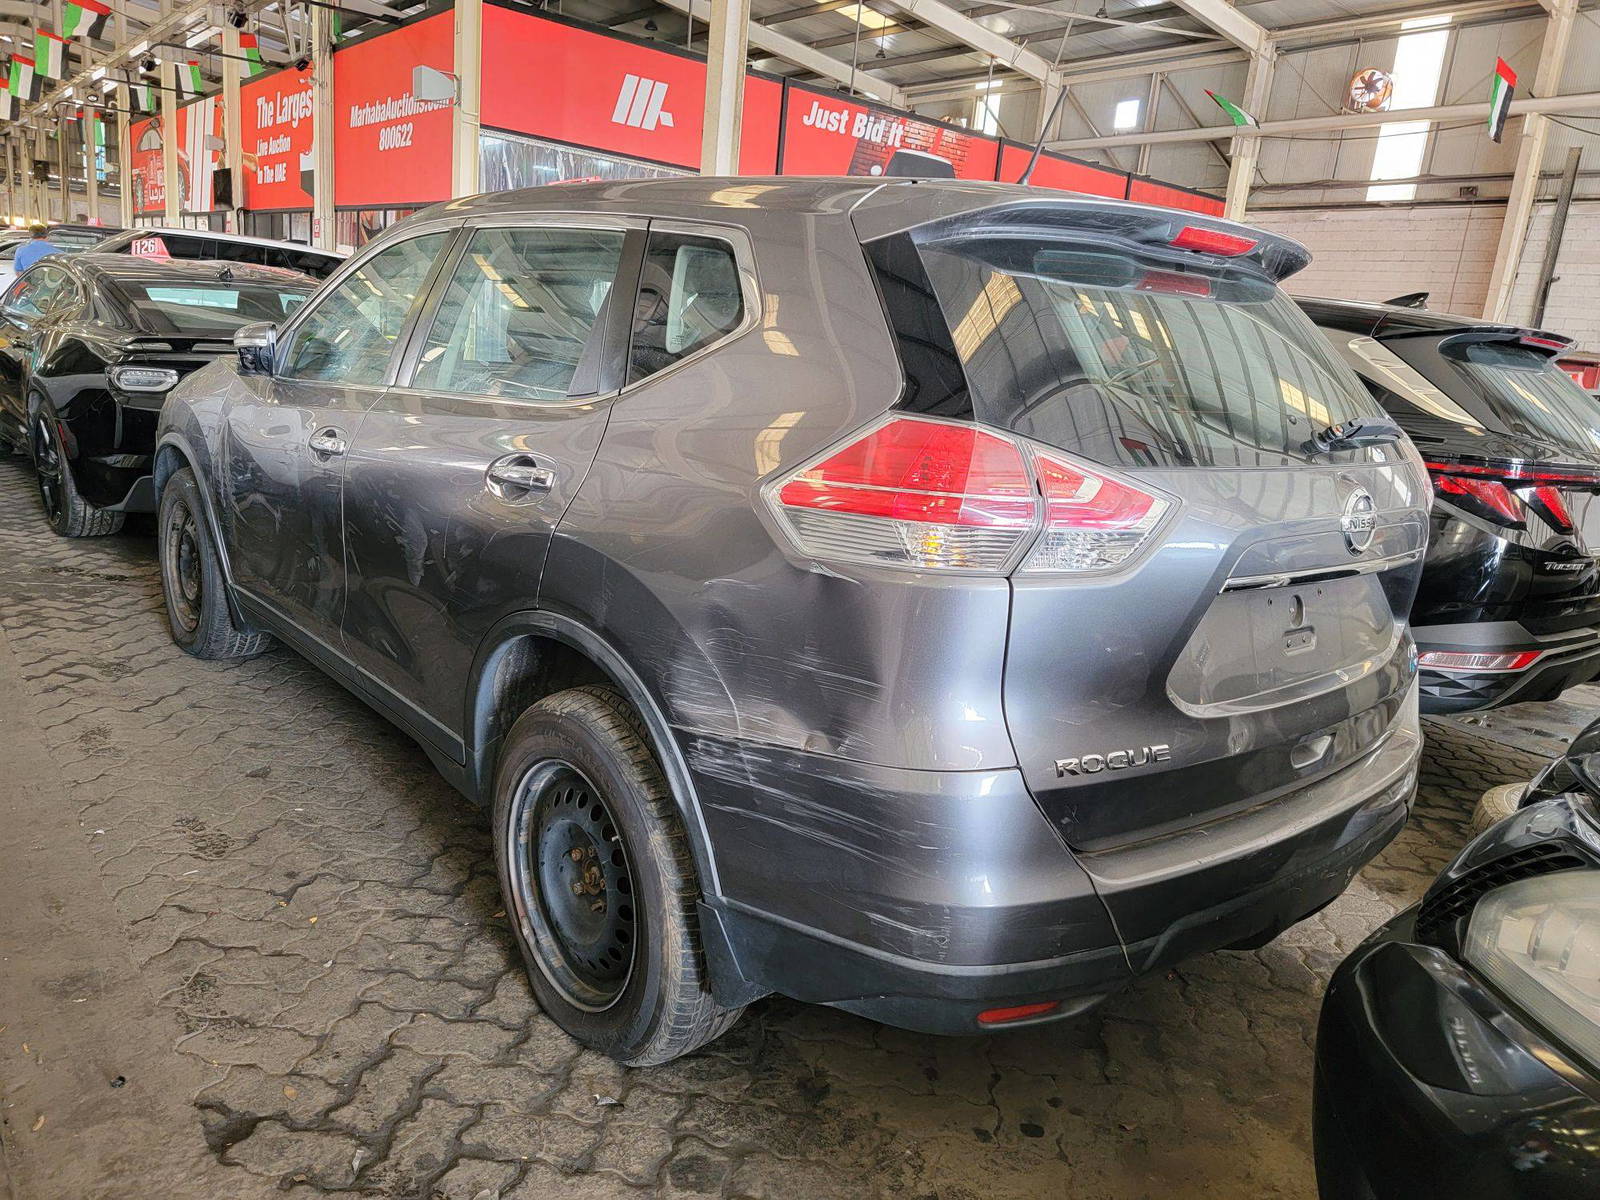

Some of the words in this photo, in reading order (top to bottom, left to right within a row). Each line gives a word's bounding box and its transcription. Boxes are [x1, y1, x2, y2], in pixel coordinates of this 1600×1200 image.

[256, 96, 274, 129] The
[275, 91, 312, 128] Larges
[379, 122, 413, 151] 800622
[803, 101, 849, 134] Just
[852, 112, 886, 143] Bid
[887, 122, 904, 148] It
[256, 139, 268, 157] Live
[269, 134, 290, 155] Auction
[264, 165, 274, 183] The
[275, 162, 287, 182] UAE
[135, 239, 155, 255] 126
[1544, 561, 1585, 571] Tucson
[1054, 744, 1171, 777] ROGUE
